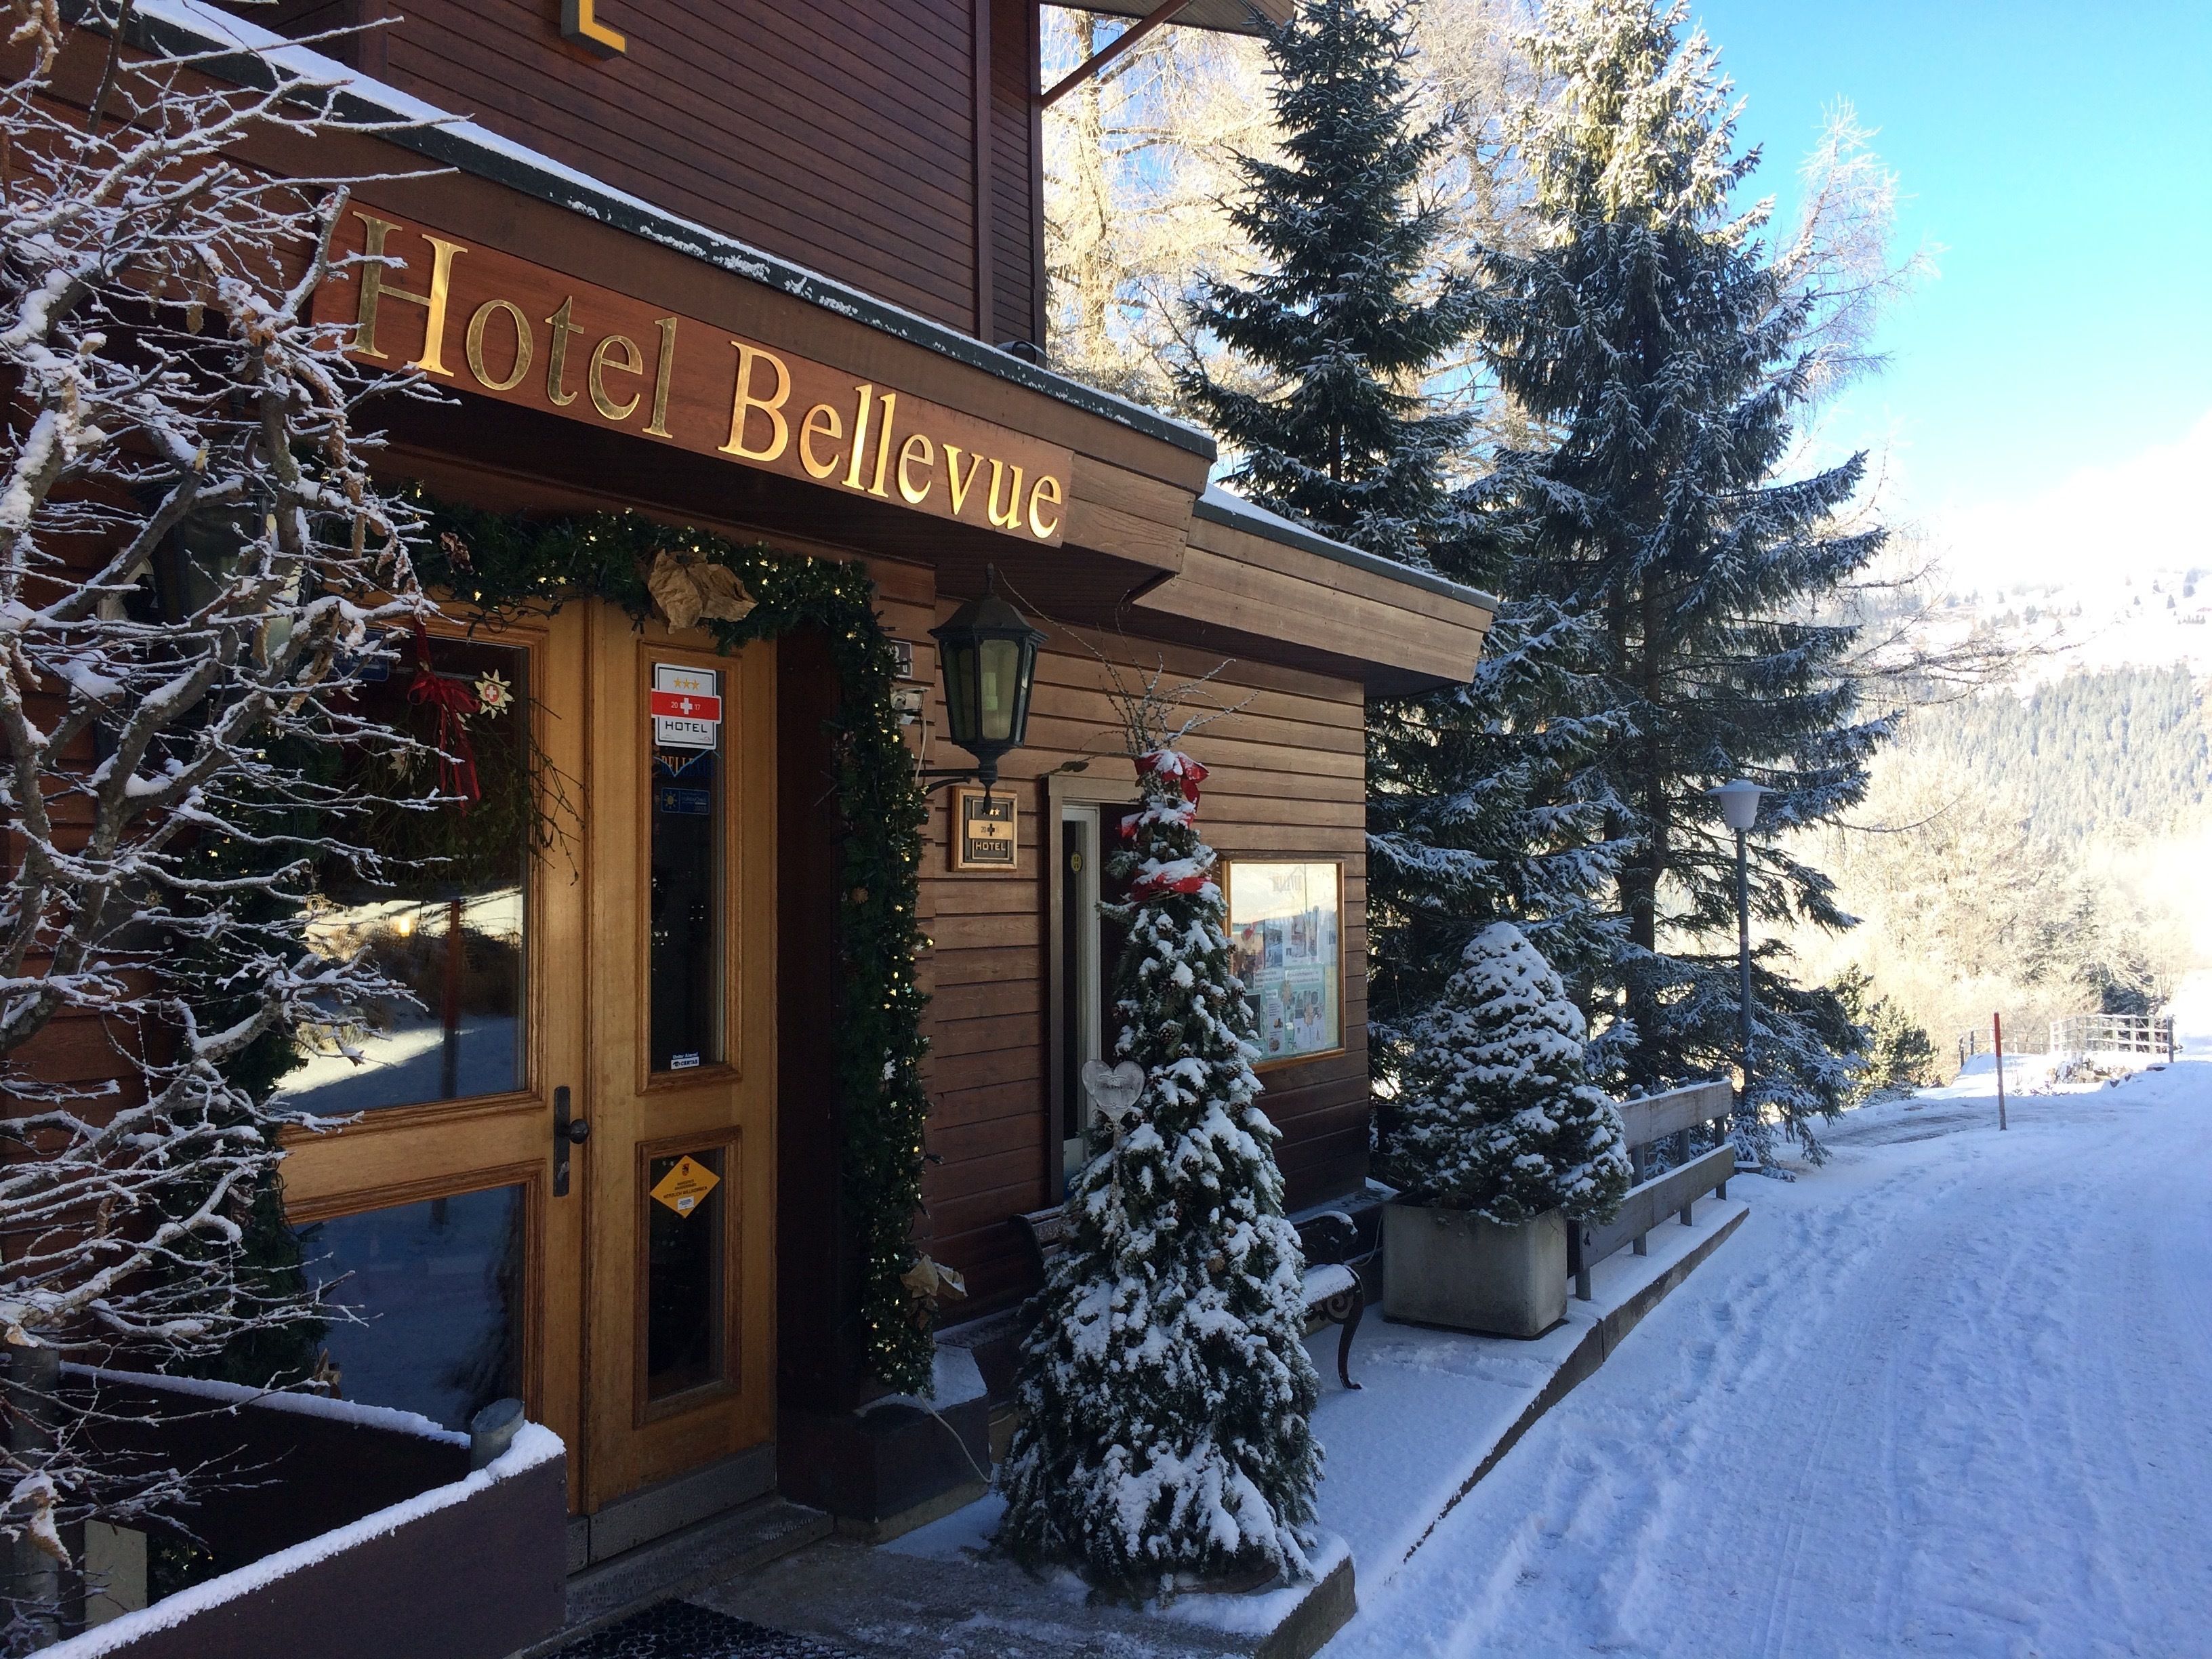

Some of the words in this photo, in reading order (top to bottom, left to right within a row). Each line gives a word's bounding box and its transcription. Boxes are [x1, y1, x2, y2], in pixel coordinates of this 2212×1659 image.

[344, 209, 678, 439] Hotel
[717, 340, 1063, 540] Bellevue
[671, 701, 678, 709] 20
[665, 720, 708, 733] HOTEL
[975, 842, 1006, 851] HOTEL
